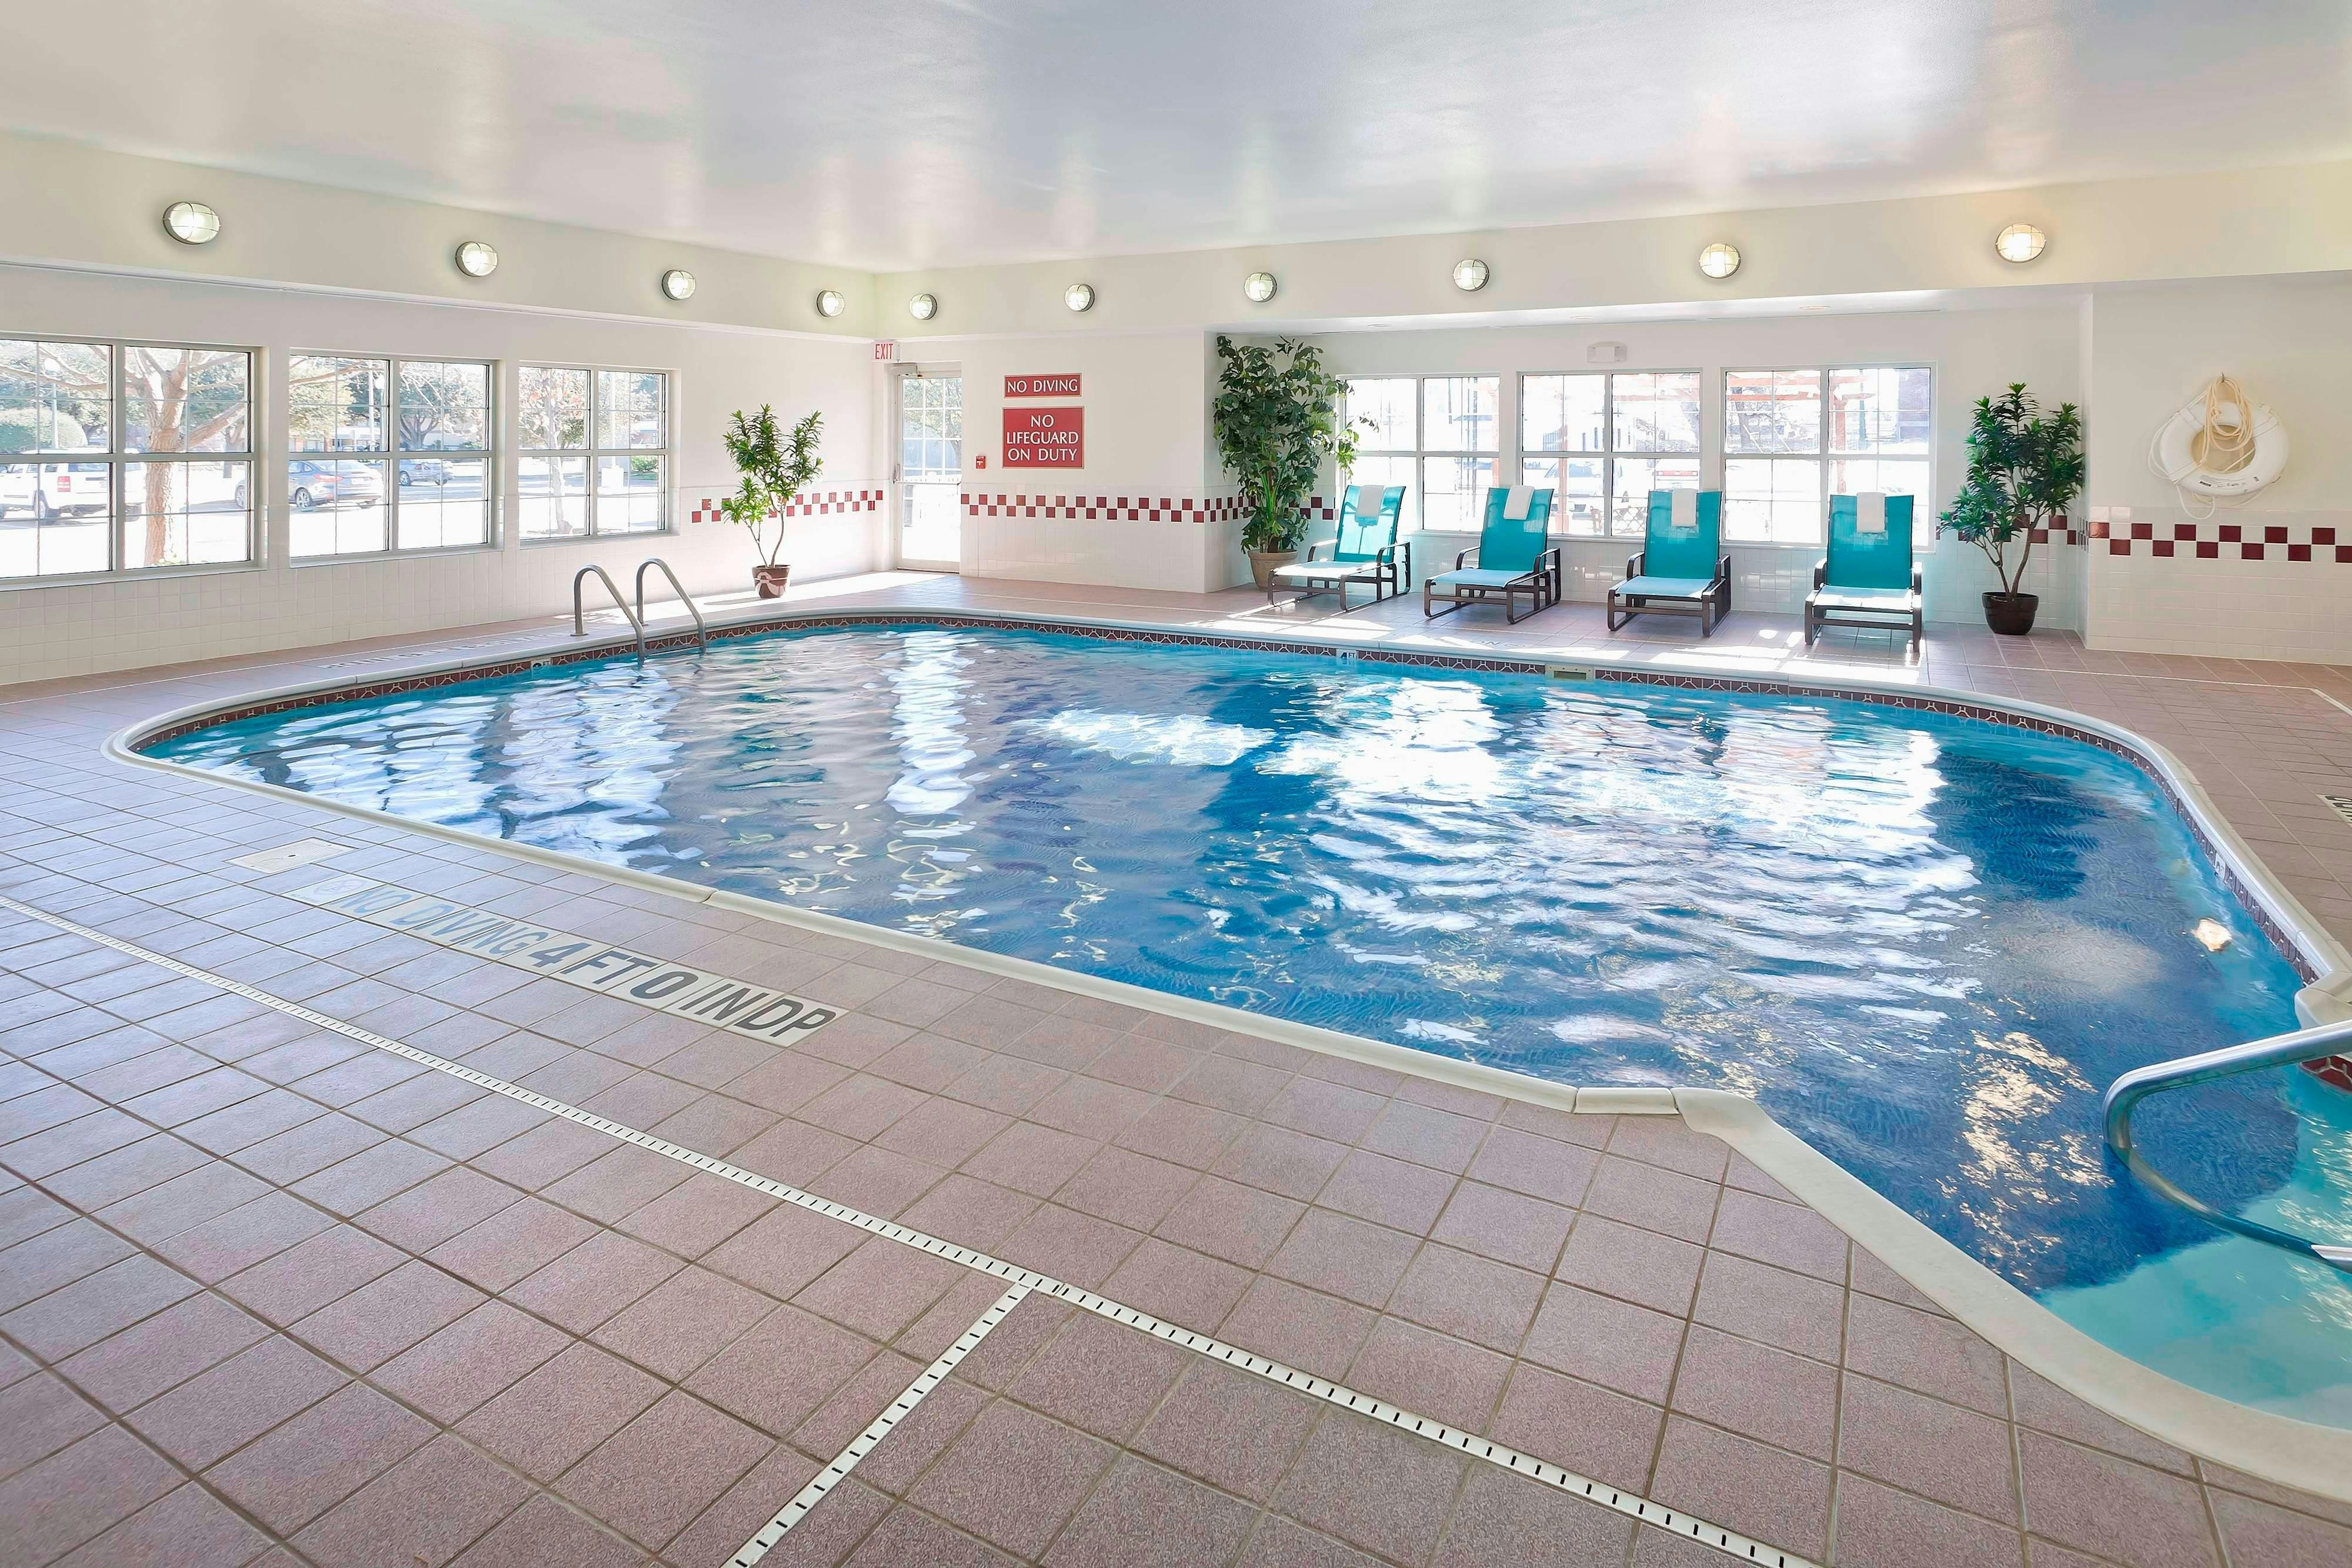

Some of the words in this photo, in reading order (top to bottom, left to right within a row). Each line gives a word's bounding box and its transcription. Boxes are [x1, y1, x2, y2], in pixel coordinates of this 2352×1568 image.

[875, 343, 893, 359] EXIT
[1007, 380, 1027, 393] NO
[1033, 379, 1078, 392] DIVING
[1031, 414, 1054, 427] NO
[1007, 432, 1078, 444] LIFEGUARD
[1008, 449, 1030, 461] ON
[1038, 449, 1077, 461] DUTY
[328, 886, 412, 913] NO
[389, 904, 549, 955] DIVING
[527, 942, 591, 968] 4
[557, 950, 660, 984] FT
